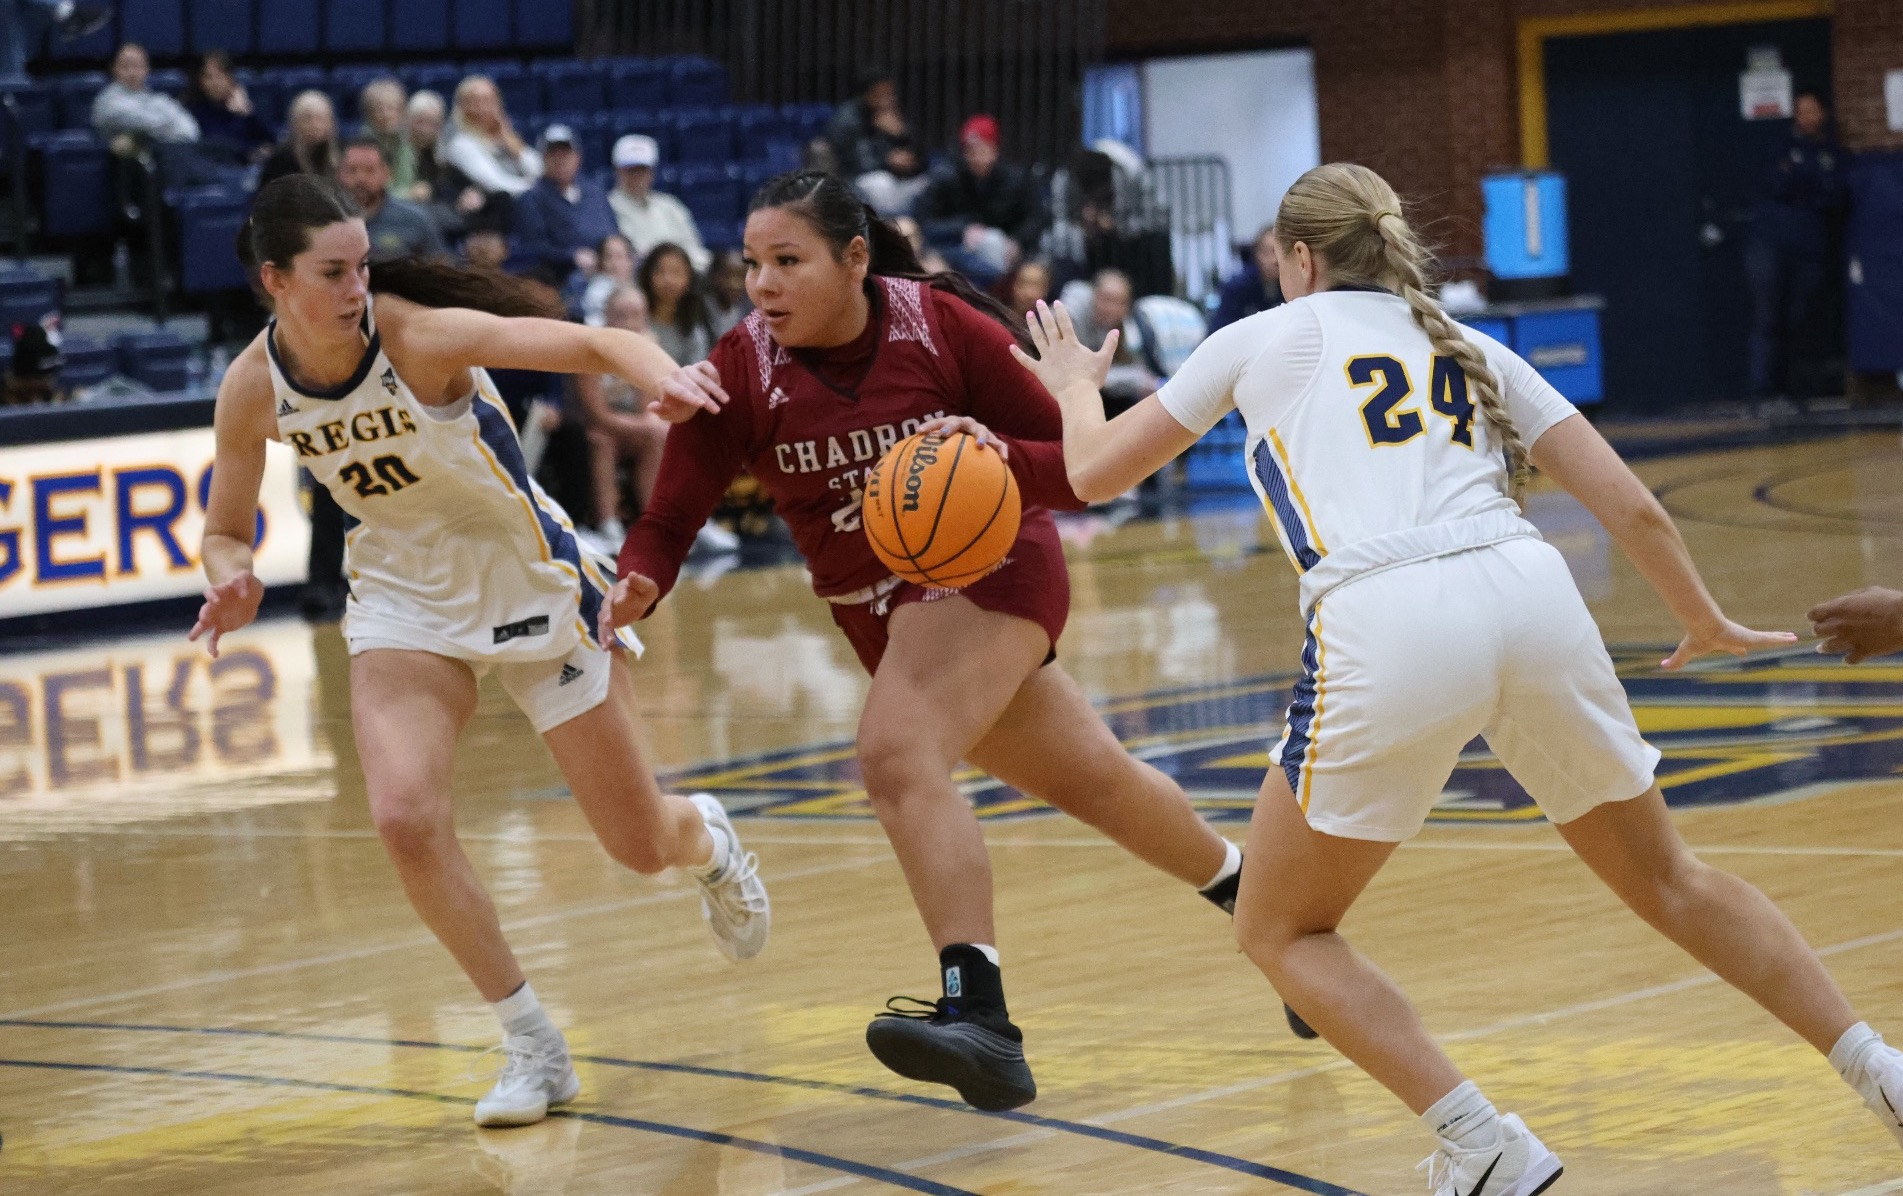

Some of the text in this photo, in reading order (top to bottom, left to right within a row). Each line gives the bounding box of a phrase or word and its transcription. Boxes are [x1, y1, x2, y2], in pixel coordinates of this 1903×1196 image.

[1343, 352, 1477, 451] 24
[288, 406, 416, 456] REGIS
[339, 453, 422, 498] 20
